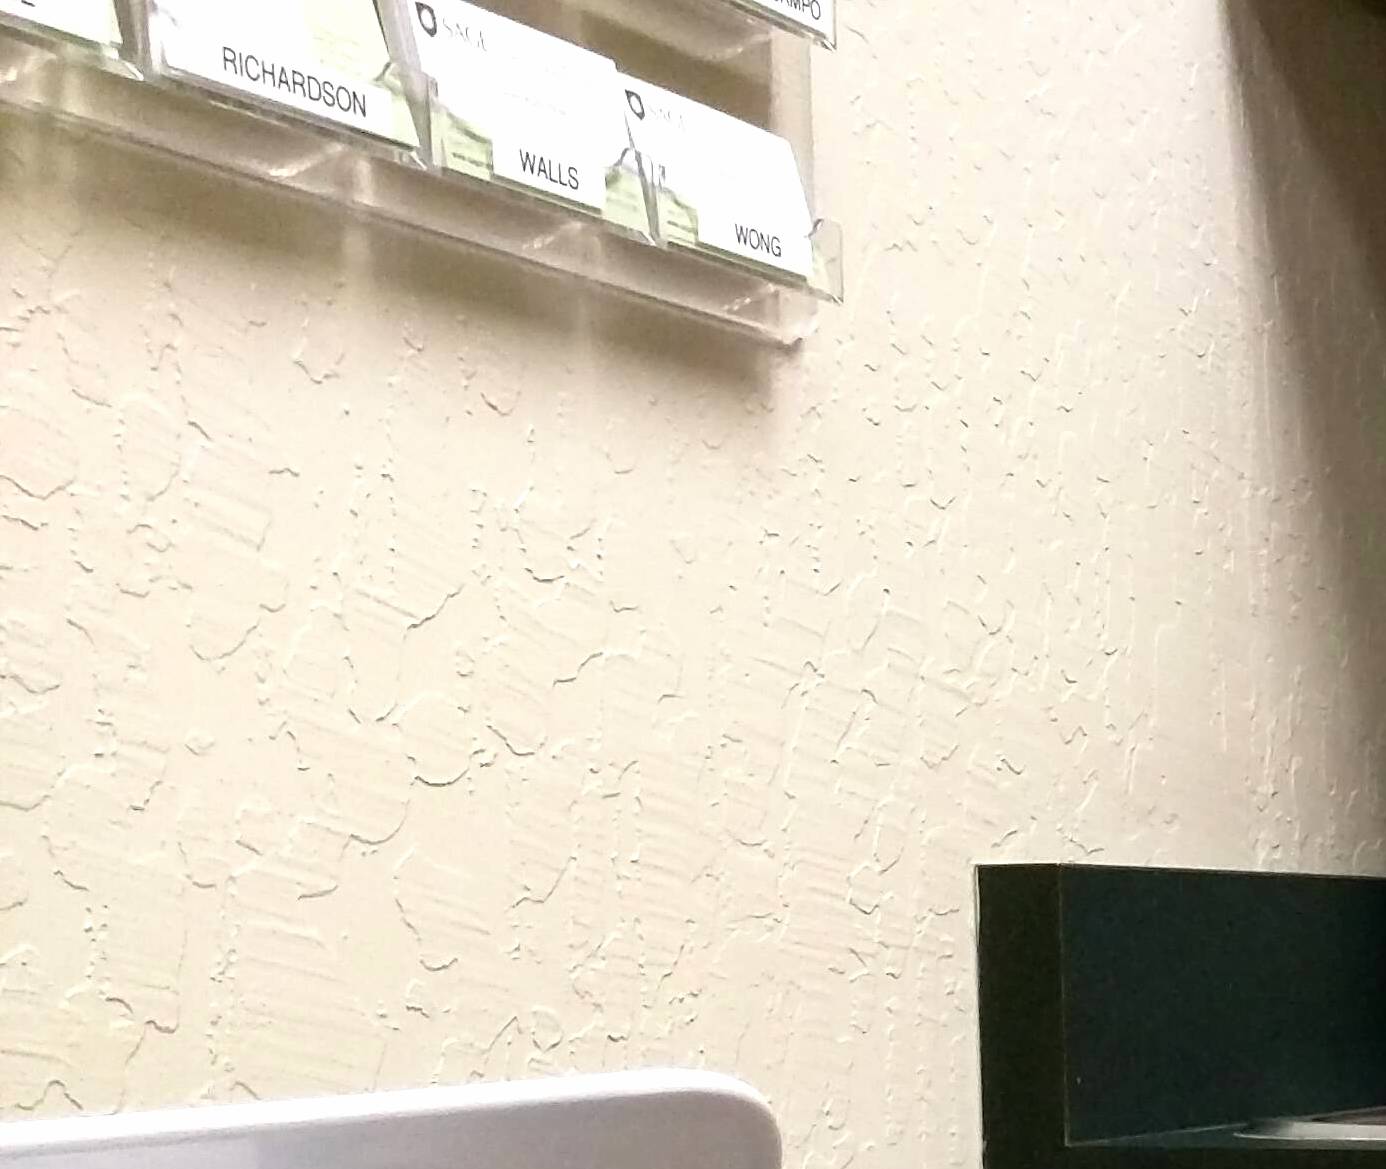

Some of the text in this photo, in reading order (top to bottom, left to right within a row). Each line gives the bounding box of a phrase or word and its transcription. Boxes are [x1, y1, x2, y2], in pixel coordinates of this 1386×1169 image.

[222, 46, 367, 118] RICHARDSON
[519, 148, 580, 190] WALLS
[735, 223, 782, 258] WONG
